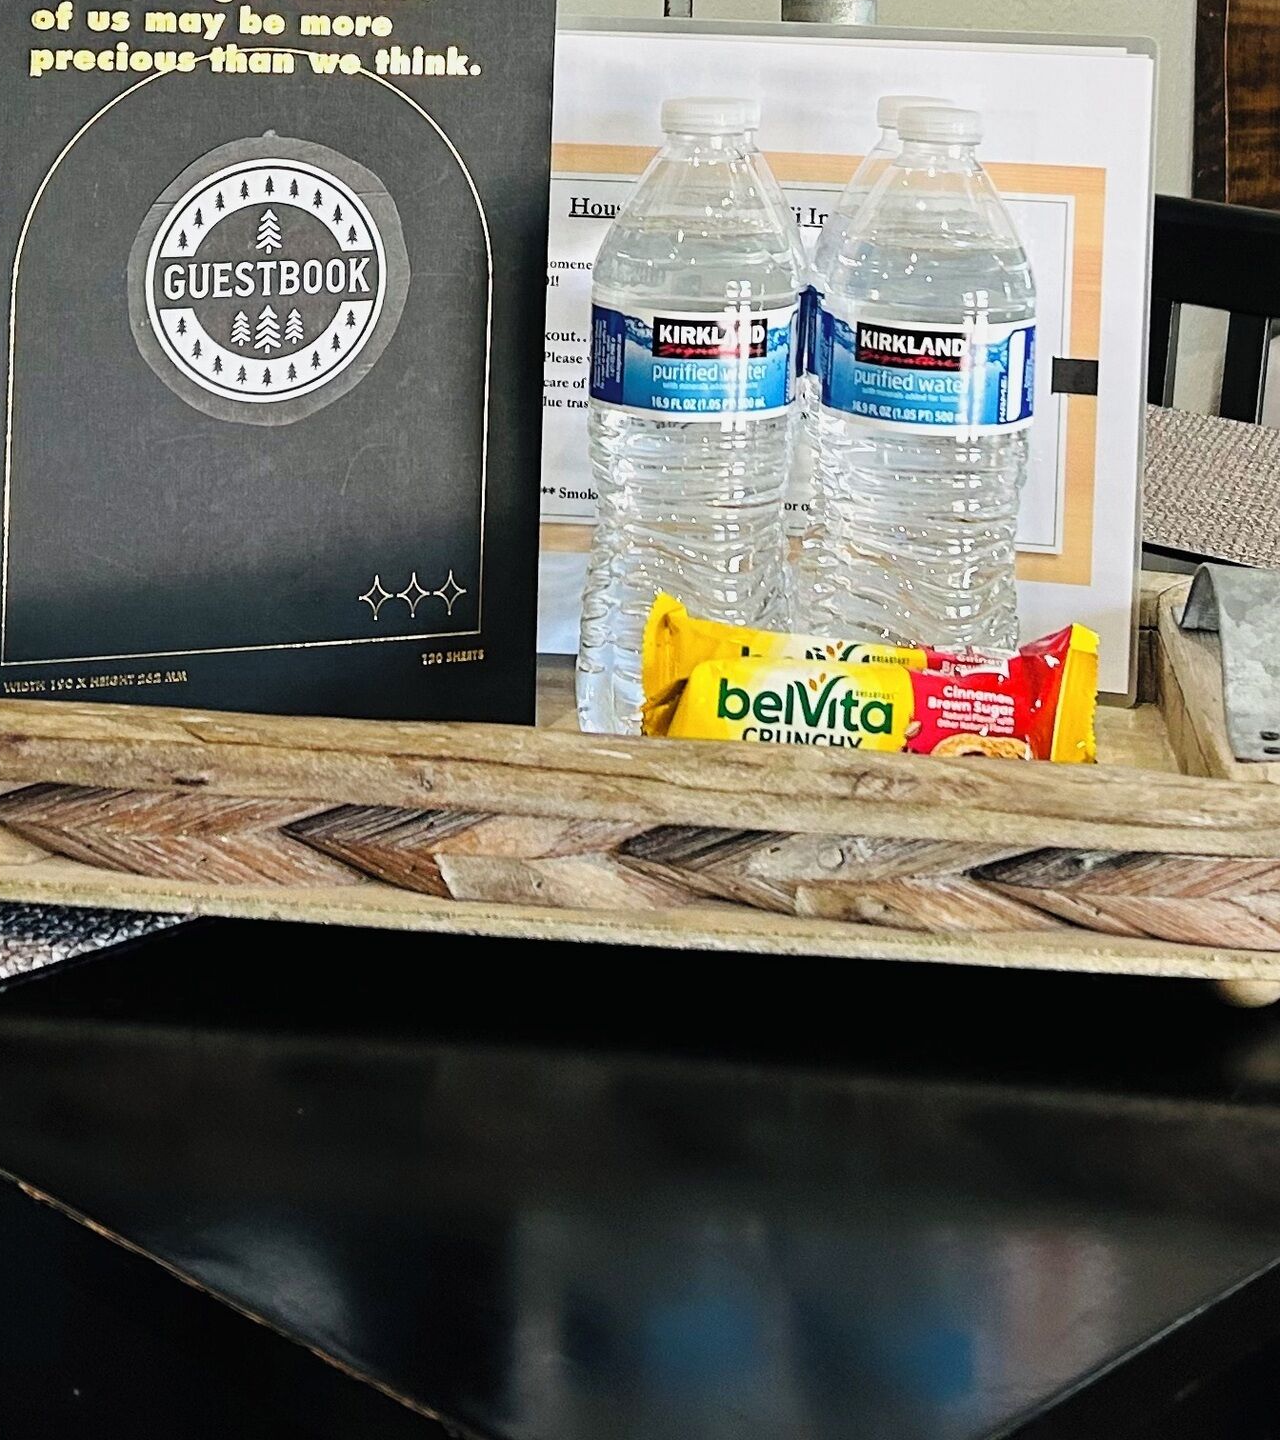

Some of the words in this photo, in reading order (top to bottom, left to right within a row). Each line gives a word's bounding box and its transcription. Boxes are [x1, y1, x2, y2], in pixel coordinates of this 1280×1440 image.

[31, 0, 73, 31] of
[87, 10, 131, 32] us
[144, 11, 227, 41] may
[239, 5, 286, 35] be
[300, 14, 393, 37] more
[29, 42, 197, 77] precious
[210, 43, 295, 74] than
[308, 51, 362, 74] we
[374, 45, 482, 76] think.
[569, 197, 621, 217] Hou
[163, 257, 371, 301] GUESTBOOK
[659, 323, 766, 346] KIRKLAD
[860, 328, 968, 357] KIRKLAND
[572, 377, 588, 389] of
[652, 363, 719, 383] purified
[853, 368, 914, 391] purified
[918, 375, 967, 394] wate
[566, 398, 590, 408] tras
[717, 675, 894, 736] belVita
[943, 684, 1015, 707] Cinnamon
[927, 696, 972, 712] Brown
[972, 700, 1015, 719] Sugar
